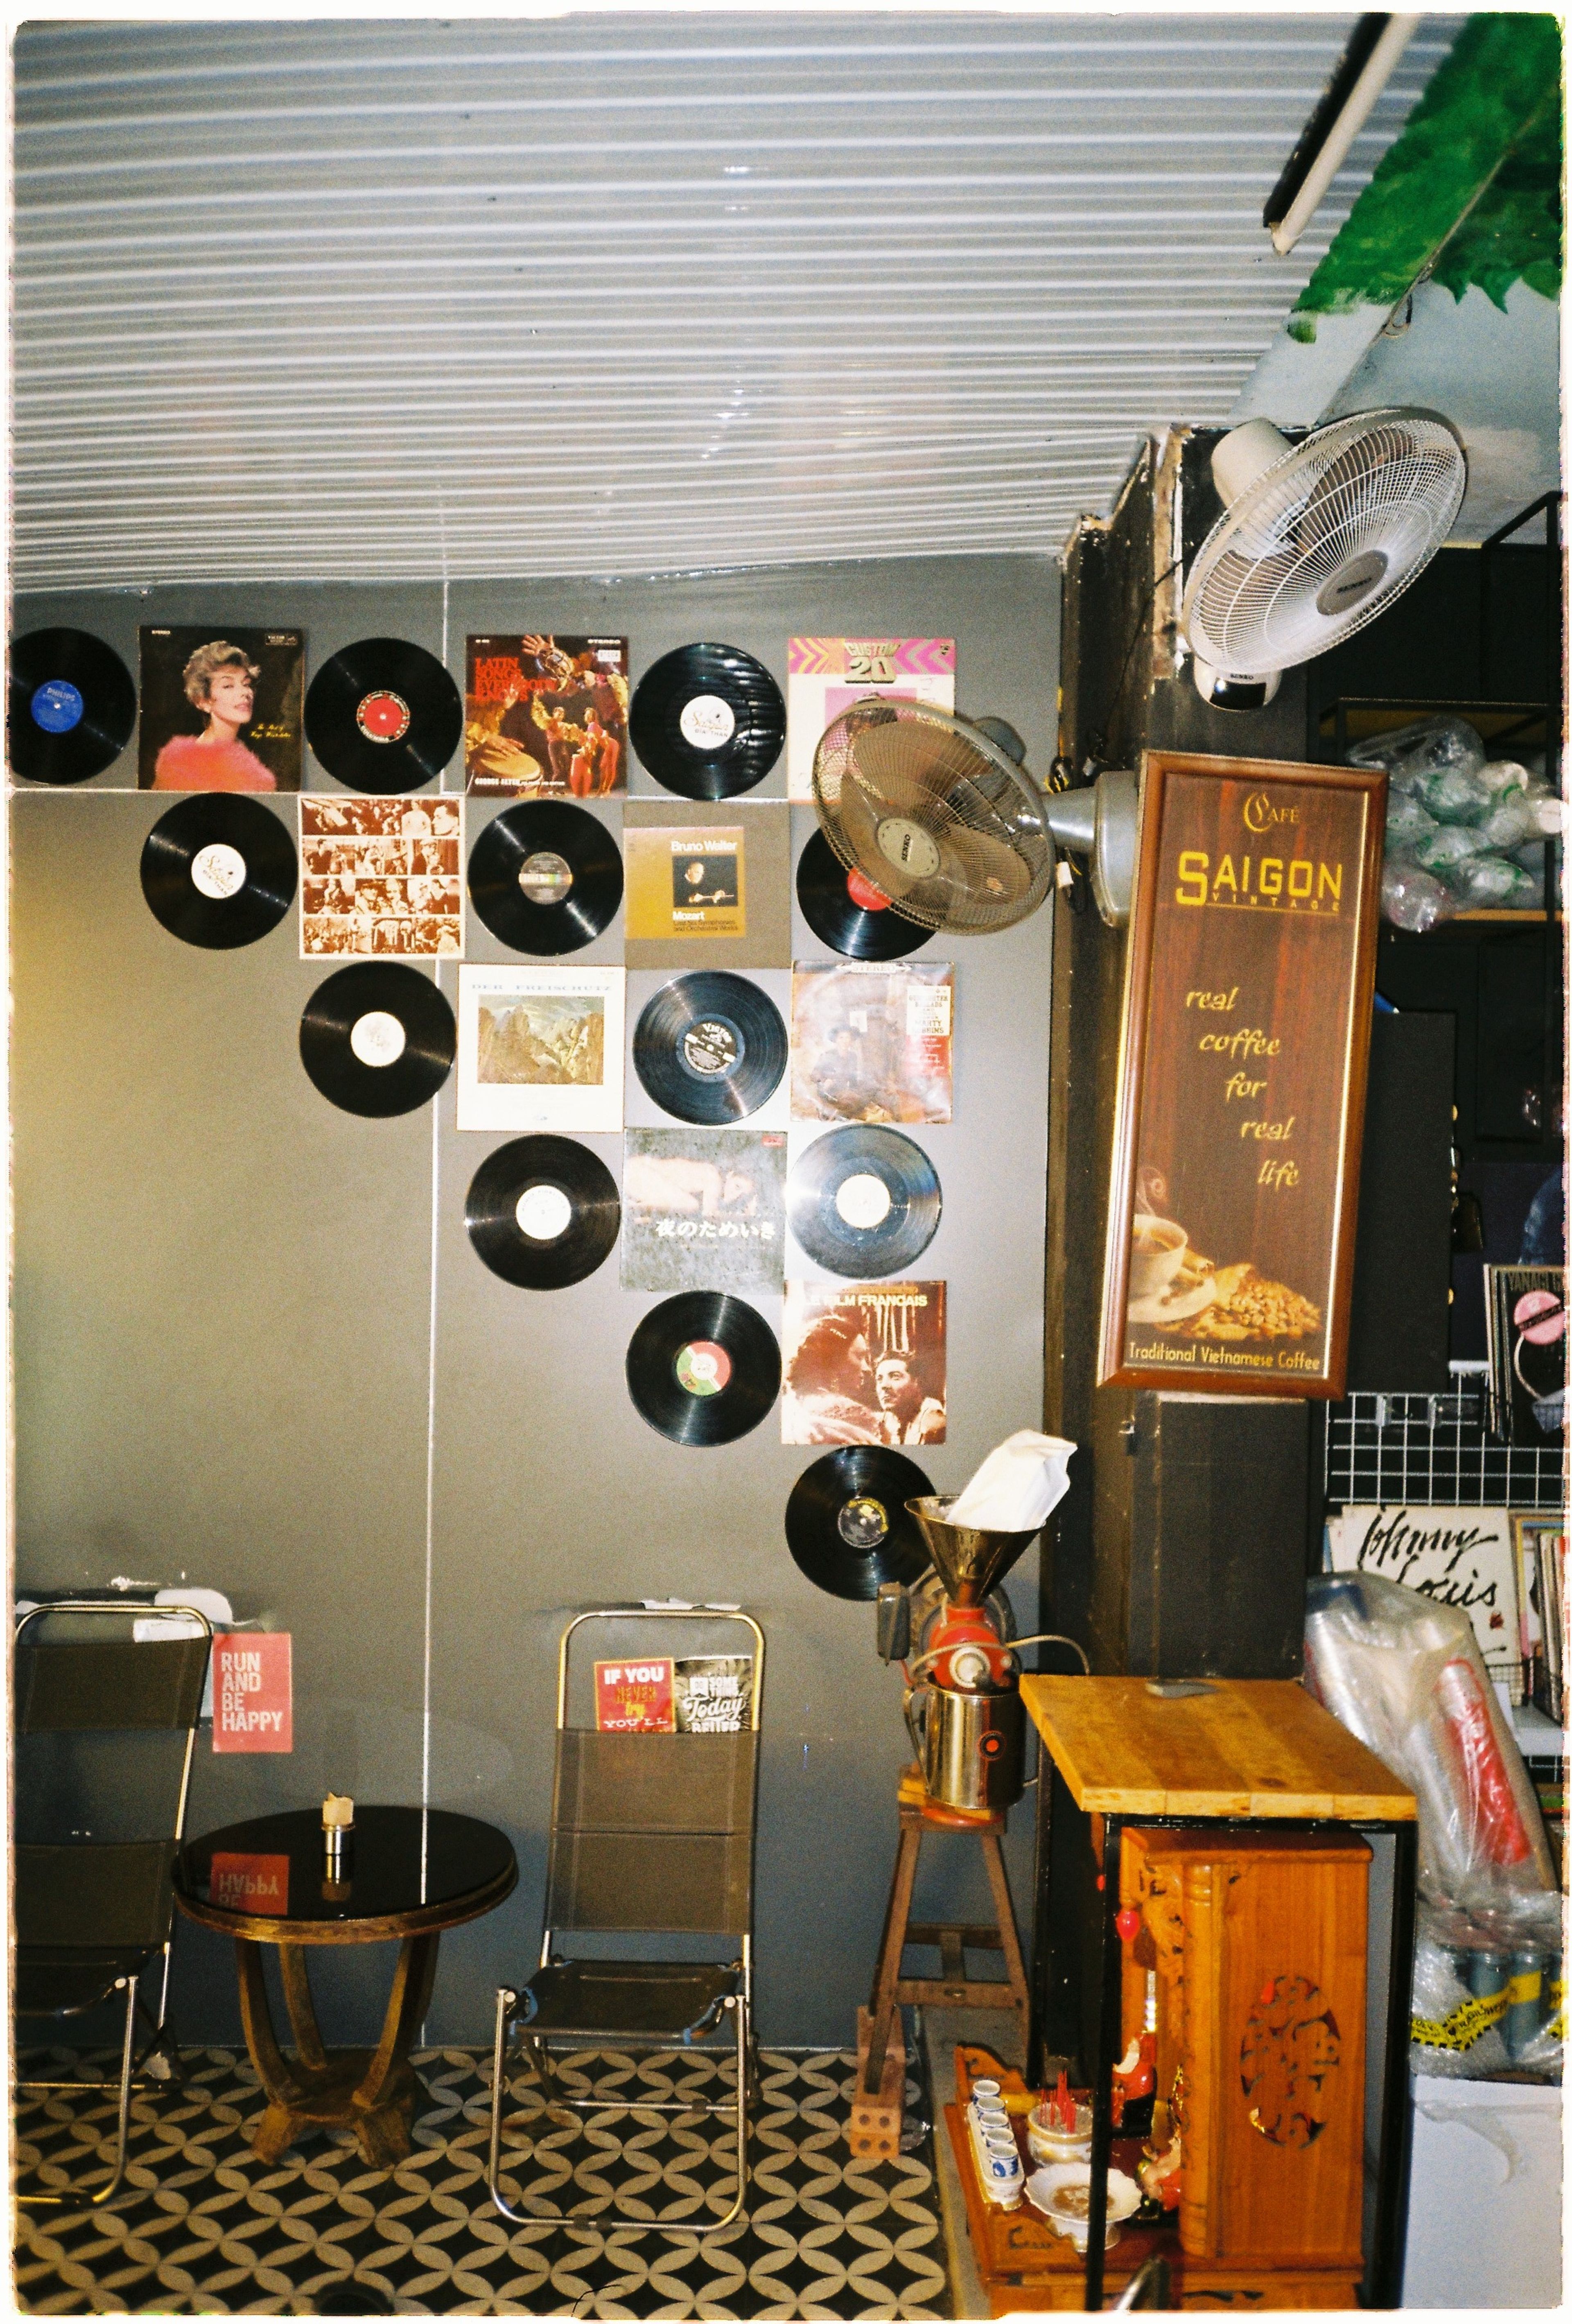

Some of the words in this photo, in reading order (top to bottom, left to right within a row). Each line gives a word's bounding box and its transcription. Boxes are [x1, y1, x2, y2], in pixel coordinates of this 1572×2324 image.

[475, 658, 519, 668] LATIN
[475, 668, 522, 679] SONGS
[844, 656, 897, 684] 20
[671, 840, 703, 851] Bruno
[704, 840, 737, 851] Walter
[901, 834, 911, 862] SENKO
[1213, 892, 1339, 912] VINTAGE
[672, 911, 705, 920] Mozart
[1186, 987, 1239, 1011] real
[1199, 1028, 1281, 1059] coffee
[1226, 1072, 1267, 1102] for
[1241, 1117, 1295, 1140] real
[1257, 1160, 1299, 1191] life
[655, 1219, 775, 1240] 夜のためいき
[1129, 1342, 1196, 1362] Traditional
[1201, 1346, 1273, 1367] Vietnamese
[1278, 1351, 1320, 1370] Coffee
[221, 1652, 260, 1672] RUN
[223, 1672, 261, 1692] AND
[604, 1669, 621, 1685] IF
[624, 1666, 664, 1684] YOU
[222, 1692, 245, 1711] BE
[682, 1697, 744, 1722] Today
[222, 1711, 282, 1732] HAPPY
